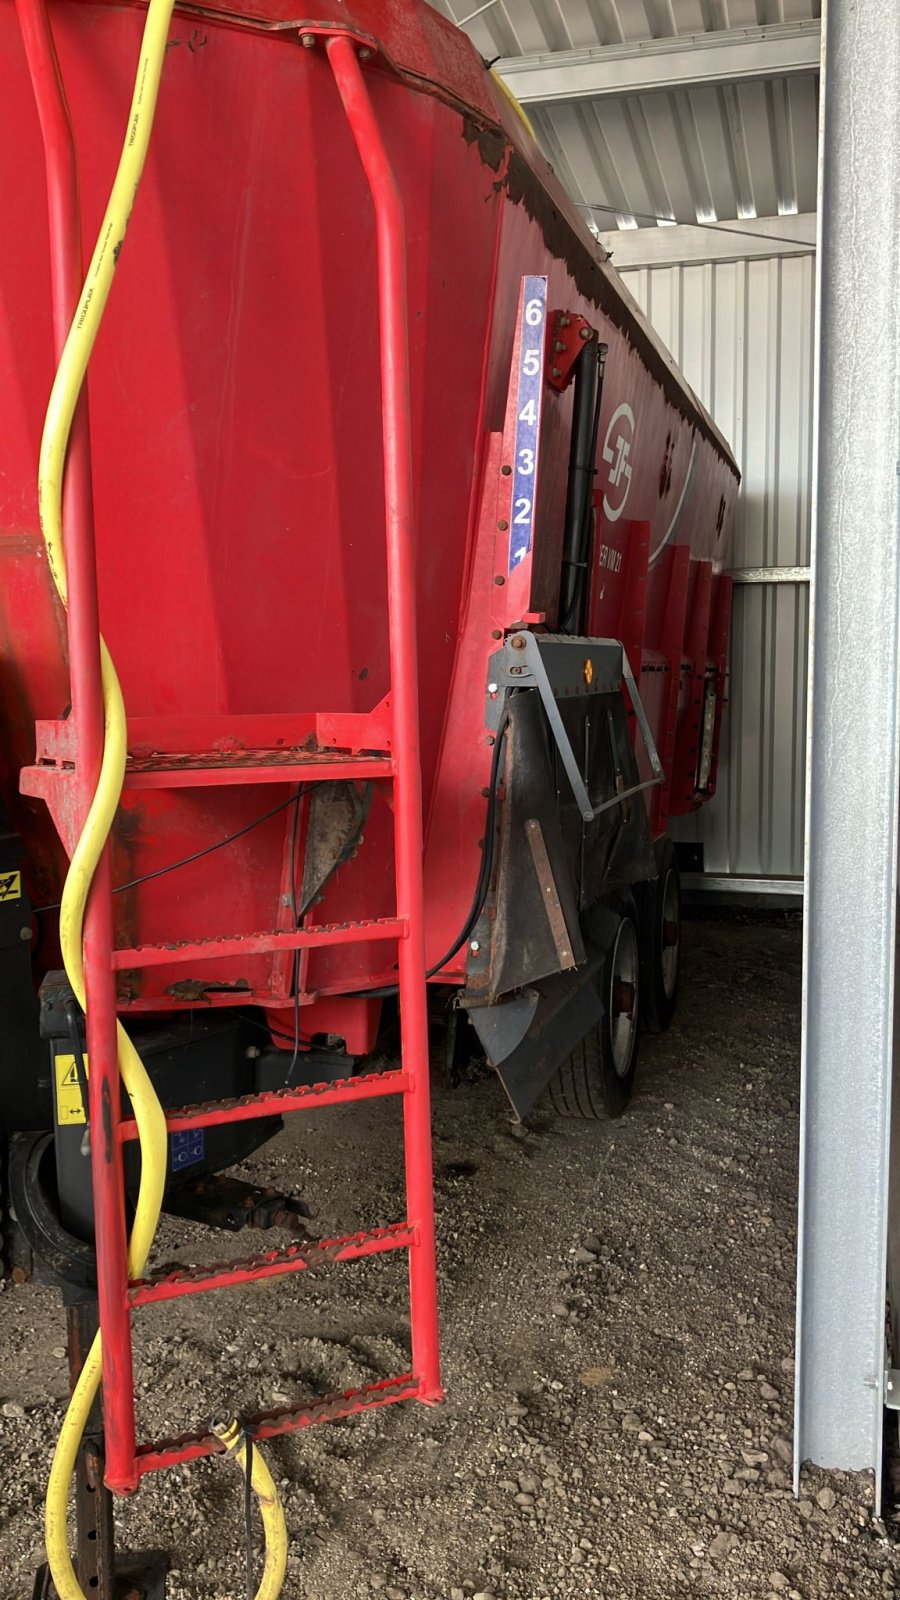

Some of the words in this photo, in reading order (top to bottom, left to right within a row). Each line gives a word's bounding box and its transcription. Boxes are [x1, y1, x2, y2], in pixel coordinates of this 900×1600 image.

[525, 299, 543, 326] 6
[522, 350, 540, 376] 5
[518, 399, 537, 426] 4
[517, 448, 535, 475] 3
[513, 498, 532, 524] 2
